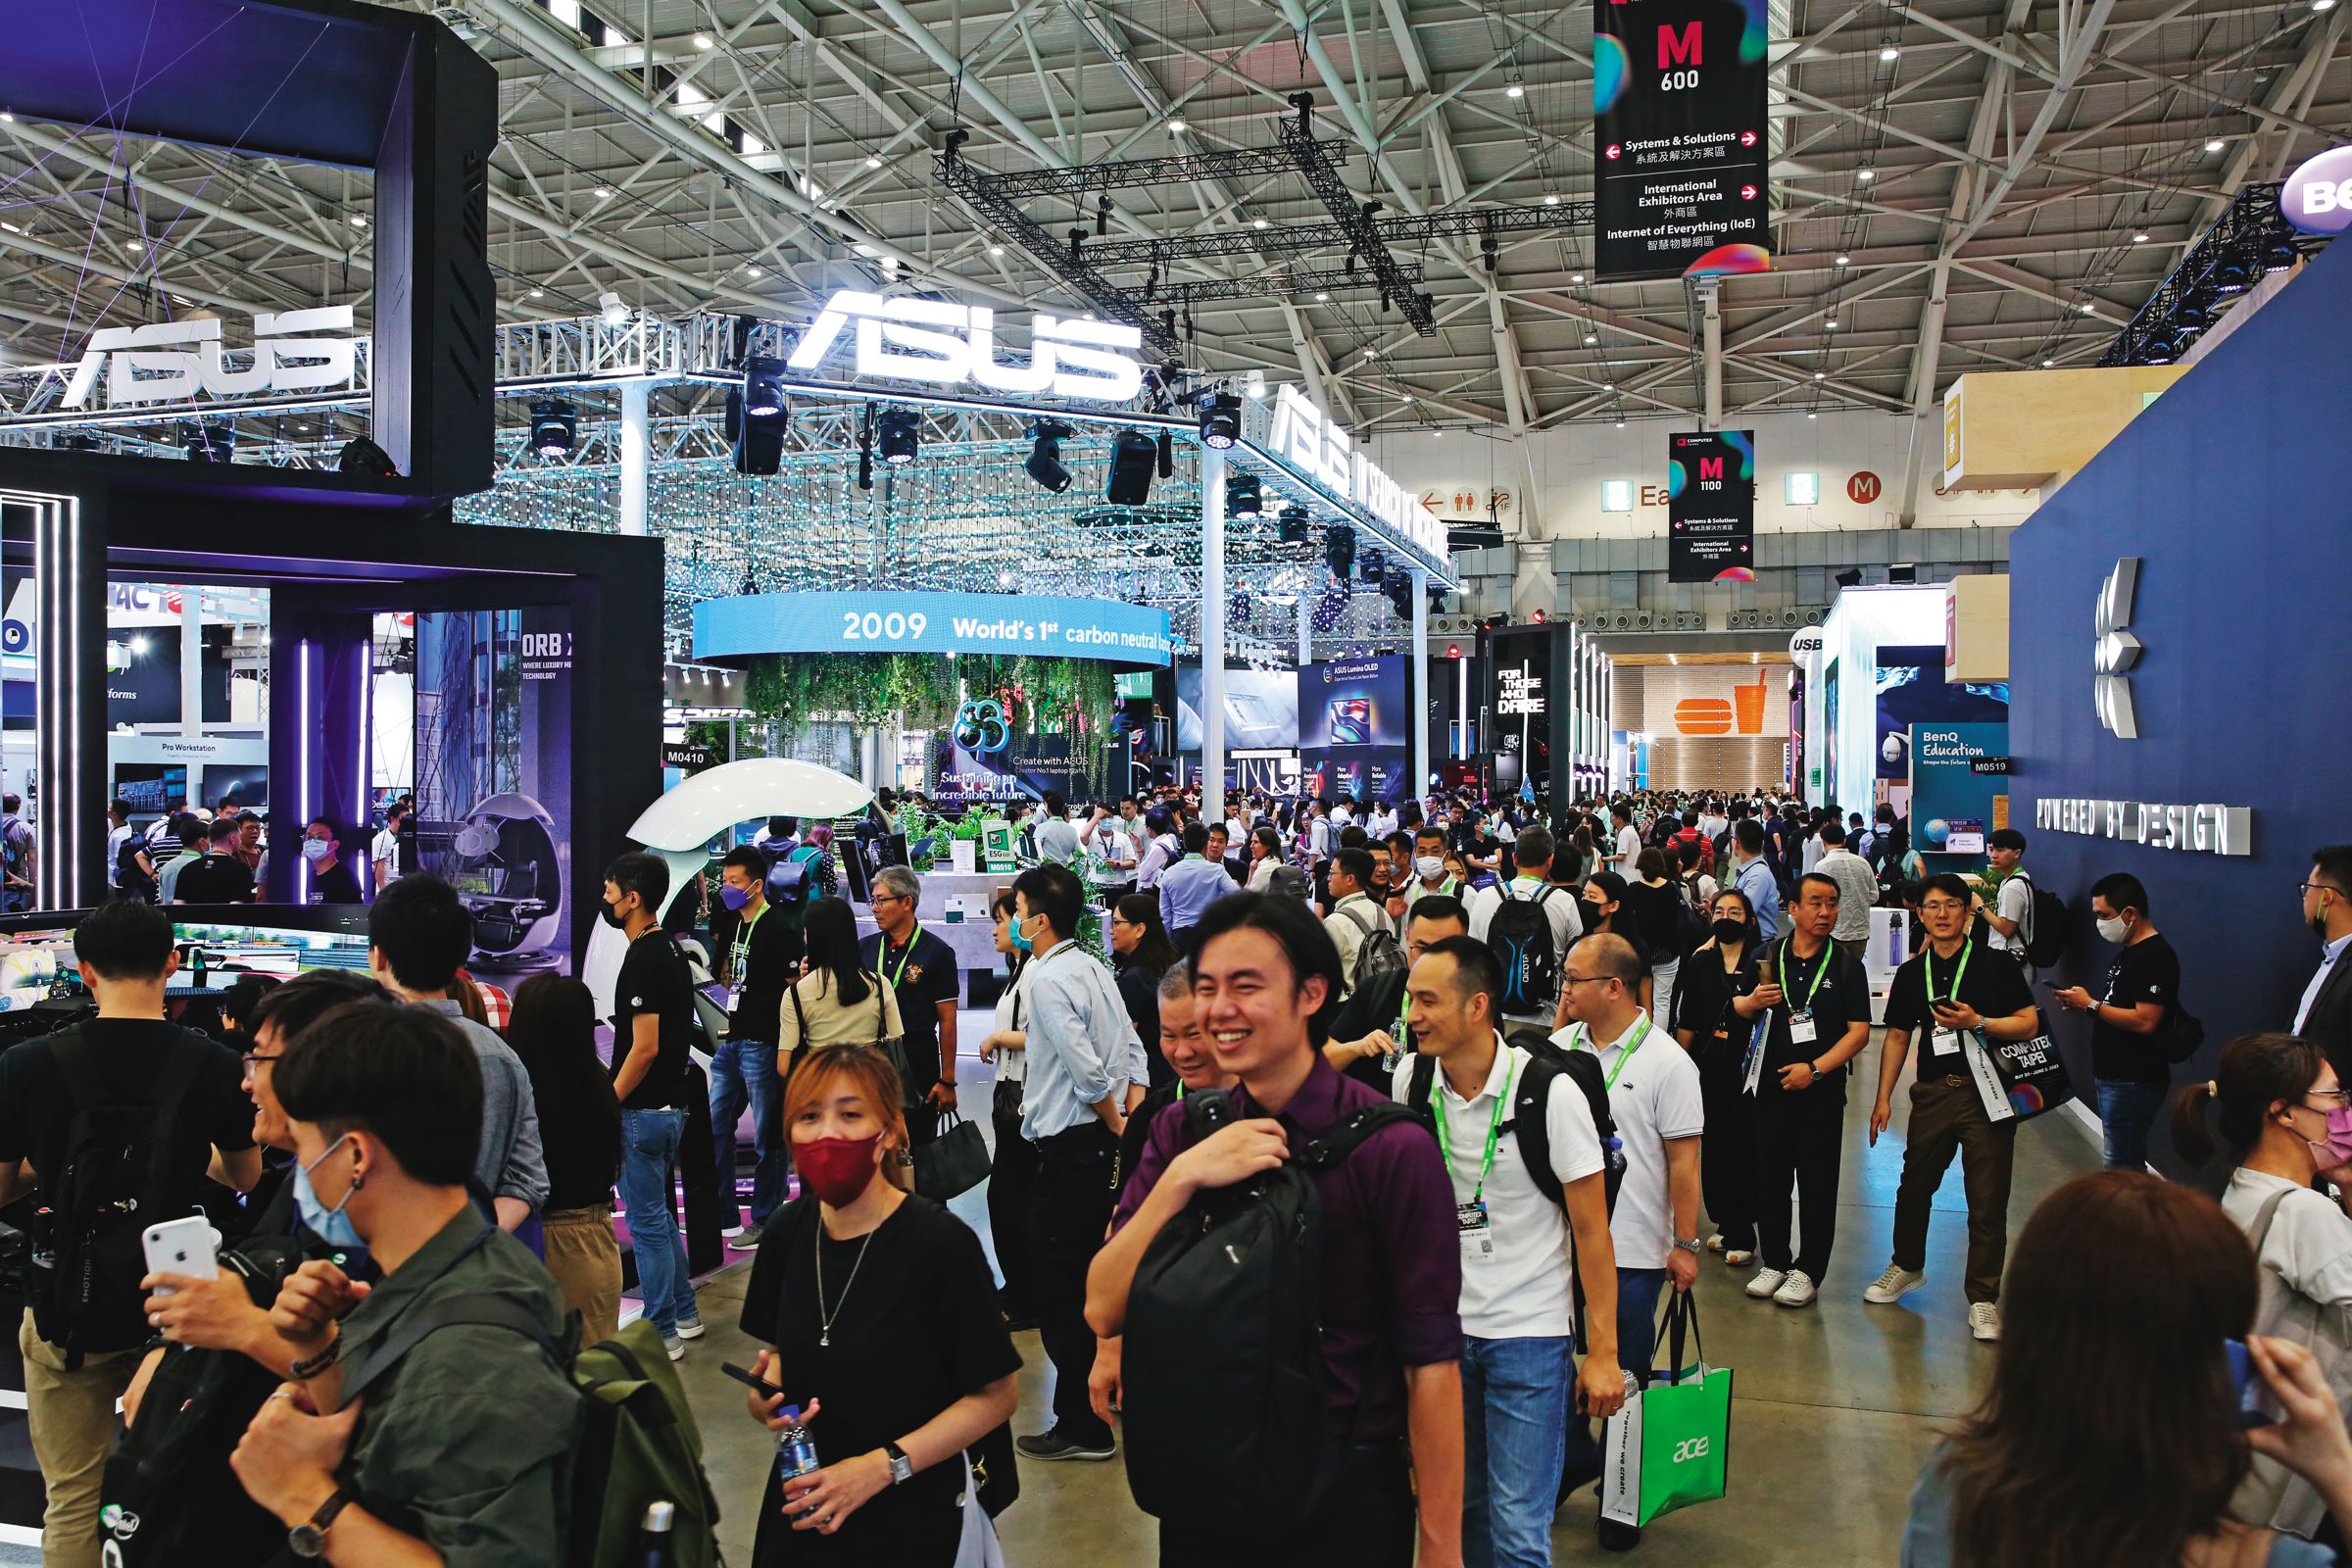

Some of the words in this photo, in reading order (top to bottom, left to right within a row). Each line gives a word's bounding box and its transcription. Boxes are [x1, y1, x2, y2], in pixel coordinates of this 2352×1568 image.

[1657, 21, 1702, 70] M
[1660, 70, 1699, 91] 600
[1625, 137, 1670, 152] Systems
[1673, 136, 1682, 147] &
[1684, 131, 1736, 146] Solutions
[1636, 146, 1726, 165] 系統及解決方案區
[1644, 179, 1716, 195] International
[1639, 193, 1694, 208] Exhibitors
[1696, 191, 1723, 204] Area
[1663, 206, 1697, 219] 外商區
[1607, 226, 1651, 240] Internet
[1653, 225, 1666, 237] of
[1667, 220, 1728, 236] Everything
[1730, 218, 1756, 232] (IoE)
[1647, 236, 1715, 252] 智慧物聯網區
[787, 290, 1142, 401] ASUS
[61, 305, 353, 408] ASUS
[1267, 383, 1350, 500] ASUS
[1700, 457, 1724, 480] M
[1700, 481, 1722, 491] 1100
[1854, 476, 1874, 498] M
[1641, 485, 1670, 507] Ea
[110, 583, 149, 610] AC
[843, 612, 927, 640] 2009
[1038, 621, 1058, 641] 1st
[1066, 626, 1118, 646] carbon
[1121, 631, 1157, 650] neutral
[521, 633, 563, 658] ORB
[1793, 639, 1822, 651] USB
[1335, 665, 1348, 674] ASUS
[1348, 664, 1364, 673] Lumina
[1364, 662, 1379, 671] OLED
[1498, 669, 1522, 679] FOR
[1503, 678, 1542, 690] THOSE
[108, 688, 137, 700] forms
[1500, 690, 1525, 699] WHO
[1498, 699, 1544, 714] DARE
[1923, 732, 1958, 743] BenQ
[175, 743, 216, 753] Workstation
[1923, 743, 1984, 757] Education
[667, 752, 704, 763] M0410
[1013, 756, 1042, 765] Create
[1044, 756, 1061, 765] with
[1976, 762, 2006, 772] M0519
[941, 772, 1001, 785] Sustaining
[932, 788, 990, 800] incredible
[991, 788, 1026, 800] future
[2036, 799, 2095, 836] POWERED
[2107, 801, 2125, 841] BY
[2137, 804, 2229, 856] DESIGN
[2000, 1035, 2052, 1058] COMPUTEX
[2017, 1051, 2048, 1068] TAIPEI
[82, 1259, 91, 1302] EMOTION
[1673, 1435, 1709, 1464] ace
[1620, 1451, 1626, 1465] we
